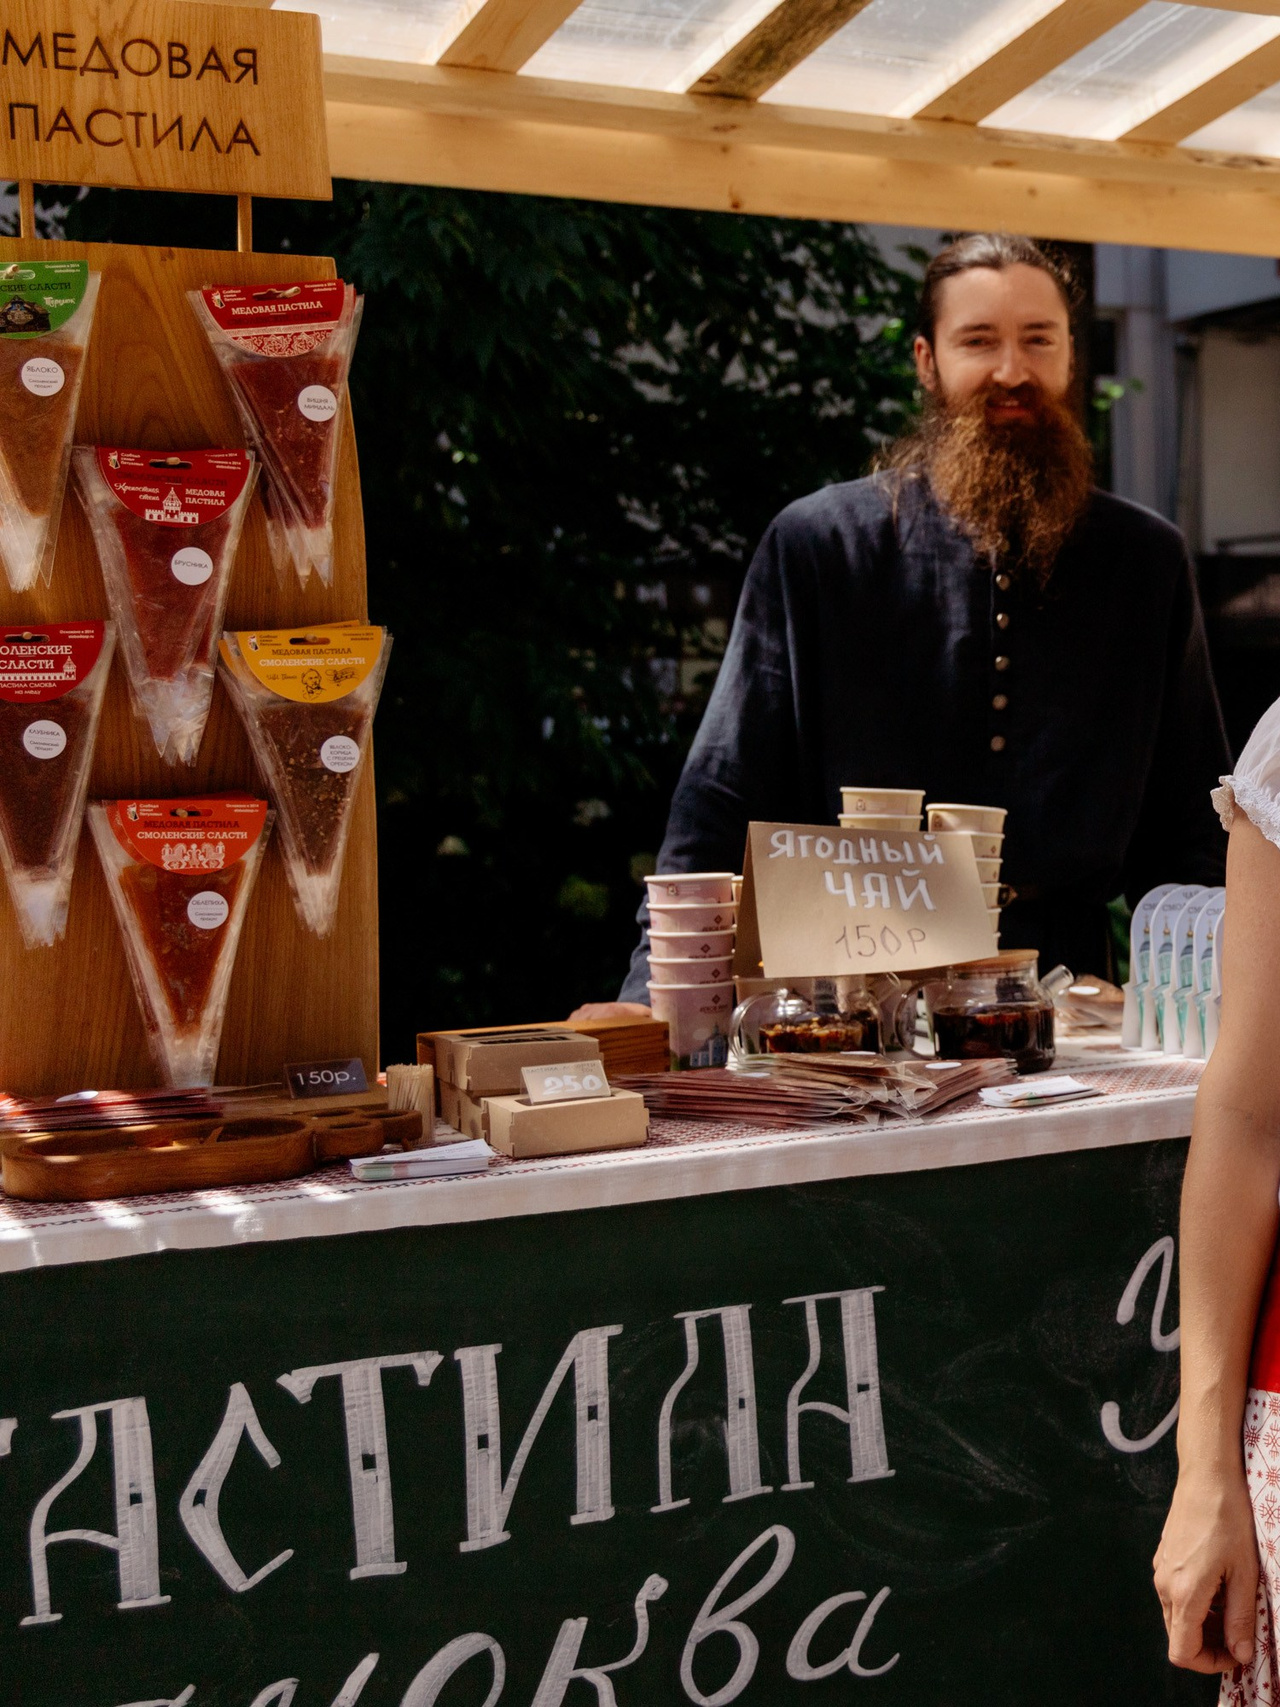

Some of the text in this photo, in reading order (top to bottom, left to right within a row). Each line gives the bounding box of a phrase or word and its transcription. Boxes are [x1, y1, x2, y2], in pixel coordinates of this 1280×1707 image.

[2, 29, 259, 85] МЕДОВАЯ
[9, 102, 261, 156] ПАСТИЛА
[29, 282, 71, 291] СЛАСТИ
[231, 300, 323, 316] МЕДОВАЯ ПАСТИЛА
[26, 365, 59, 374] ЯБЛОКО
[116, 471, 228, 486] СМОЛЕНСКИЕ СЛАСТИ
[185, 488, 226, 498] МЕДОВАЯ
[185, 497, 226, 506] ПАСТИЛА
[174, 559, 209, 569] БРУСНИКА
[271, 647, 352, 656] МЕДОВАЯ ПАСТИЛА
[0, 659, 55, 670] СЛАСТИ
[259, 656, 366, 667] СМОЛЕНСКИЕ СЛАСТИ
[29, 728, 60, 737] КЛУБНИКА
[144, 820, 240, 829] МЕДОВАЯ ПАСТИЛА
[136, 831, 248, 840] СМОЛЕНСКИЕ СЛАСТИ
[824, 868, 937, 912] ЧАЙ
[543, 1074, 604, 1096] 250
[0, 1285, 897, 1628] АСТИЛА
[113, 1524, 900, 1707] оква
